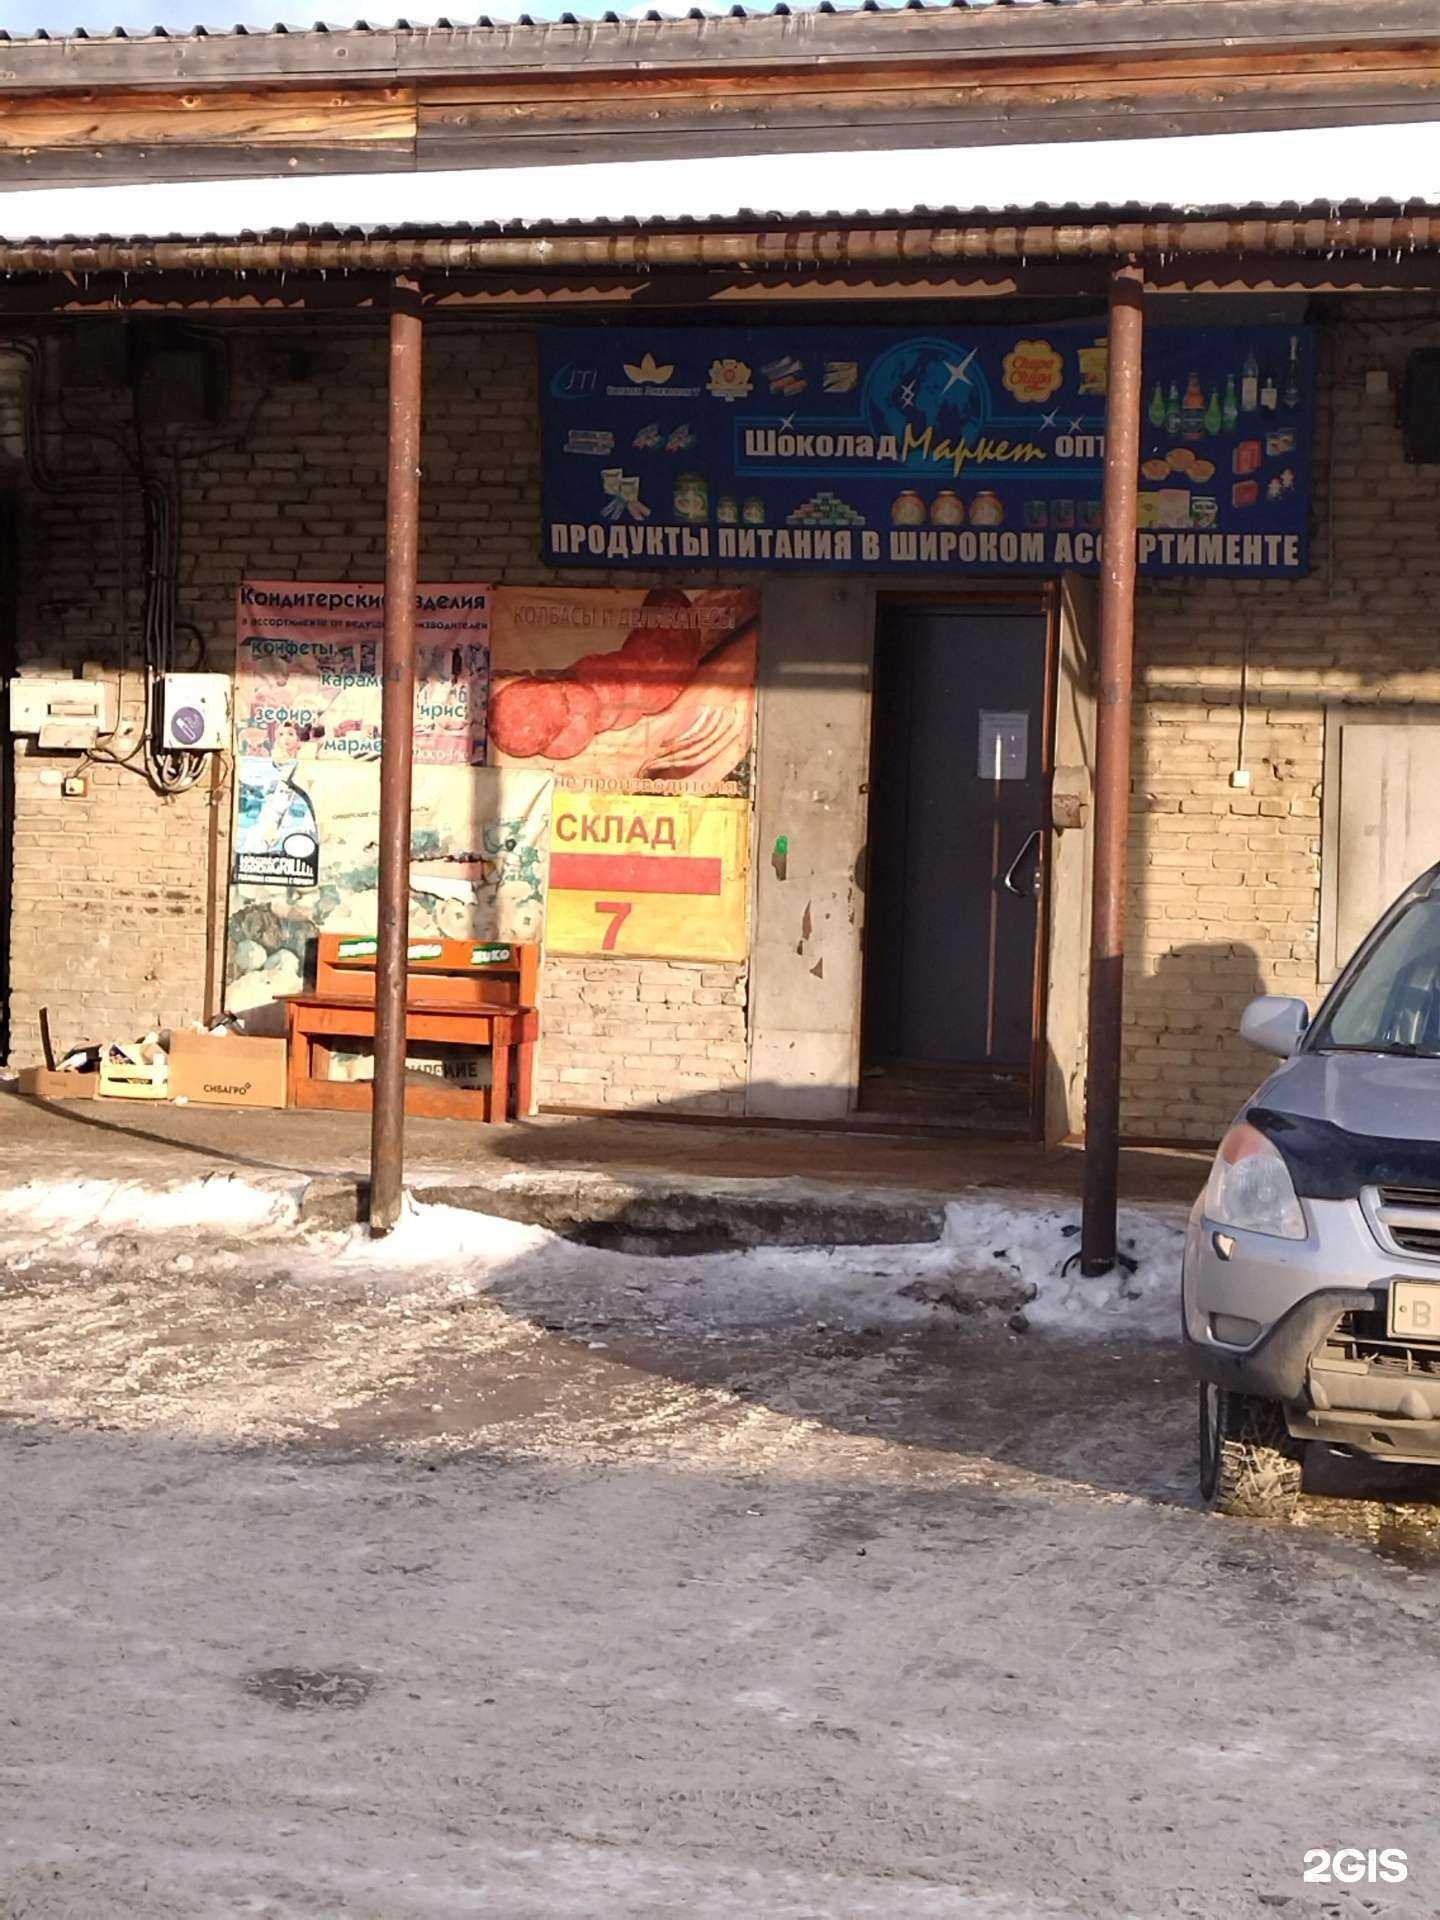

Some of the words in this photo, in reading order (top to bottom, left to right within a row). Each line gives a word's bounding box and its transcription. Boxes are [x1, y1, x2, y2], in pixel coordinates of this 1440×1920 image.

[745, 429, 898, 460] Шоколад
[901, 422, 1046, 477] Маркет
[551, 524, 709, 559] ПРОДУКТЫ
[719, 527, 851, 560] ПИТАНИЯ
[862, 530, 879, 560] В
[890, 531, 1044, 563] ШИРОКОМ
[1054, 532, 1299, 566] АСРТИМЕНТЕ
[241, 588, 384, 612] Кондитерски
[415, 592, 486, 611] зделия
[514, 607, 597, 626] КОЛБАСЫ
[555, 813, 676, 850] СКЛАД
[594, 902, 632, 951] 7
[203, 1084, 247, 1096] СИБАГРО
